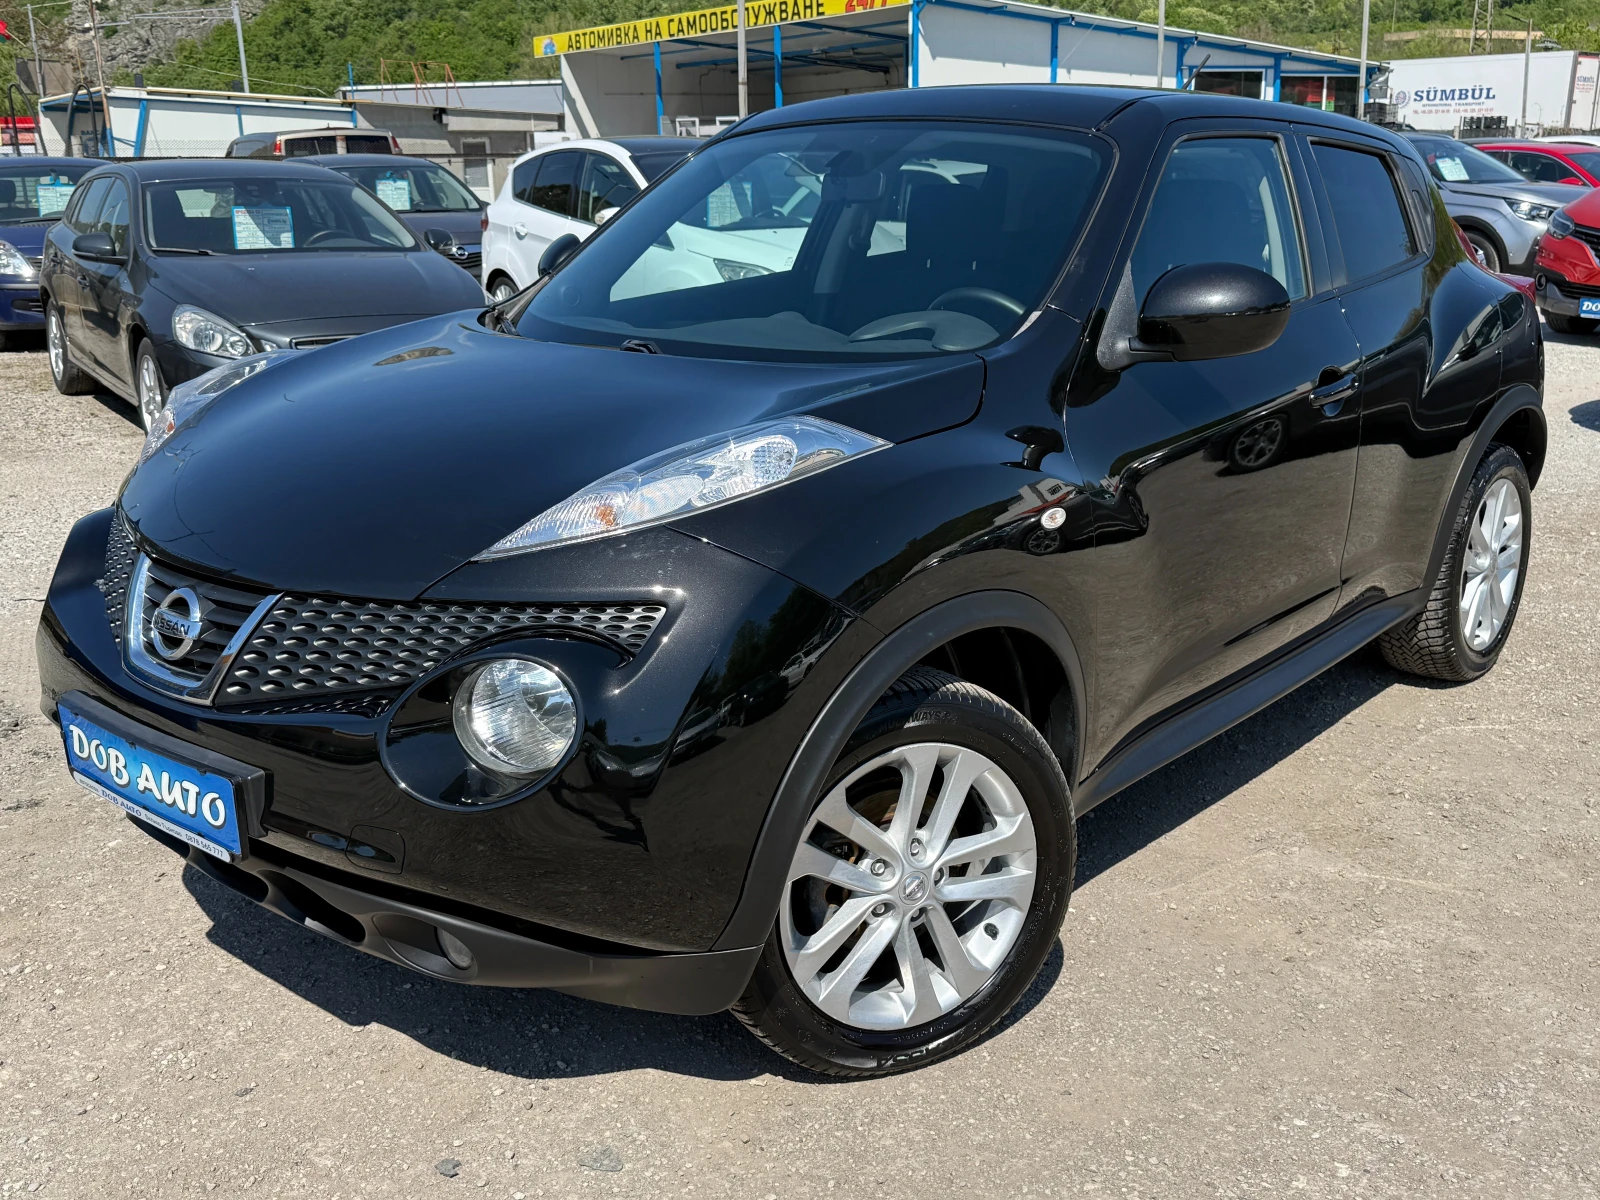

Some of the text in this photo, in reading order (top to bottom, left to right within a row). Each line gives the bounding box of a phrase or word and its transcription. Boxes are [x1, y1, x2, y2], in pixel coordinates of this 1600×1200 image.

[567, 24, 640, 52] АВТОМИВКА
[645, 20, 662, 41] НА
[1413, 84, 1496, 102] SÜMBÜL
[69, 724, 226, 827] DOB AUTO
[101, 789, 119, 805] DOB
[120, 801, 142, 817] AUTO
